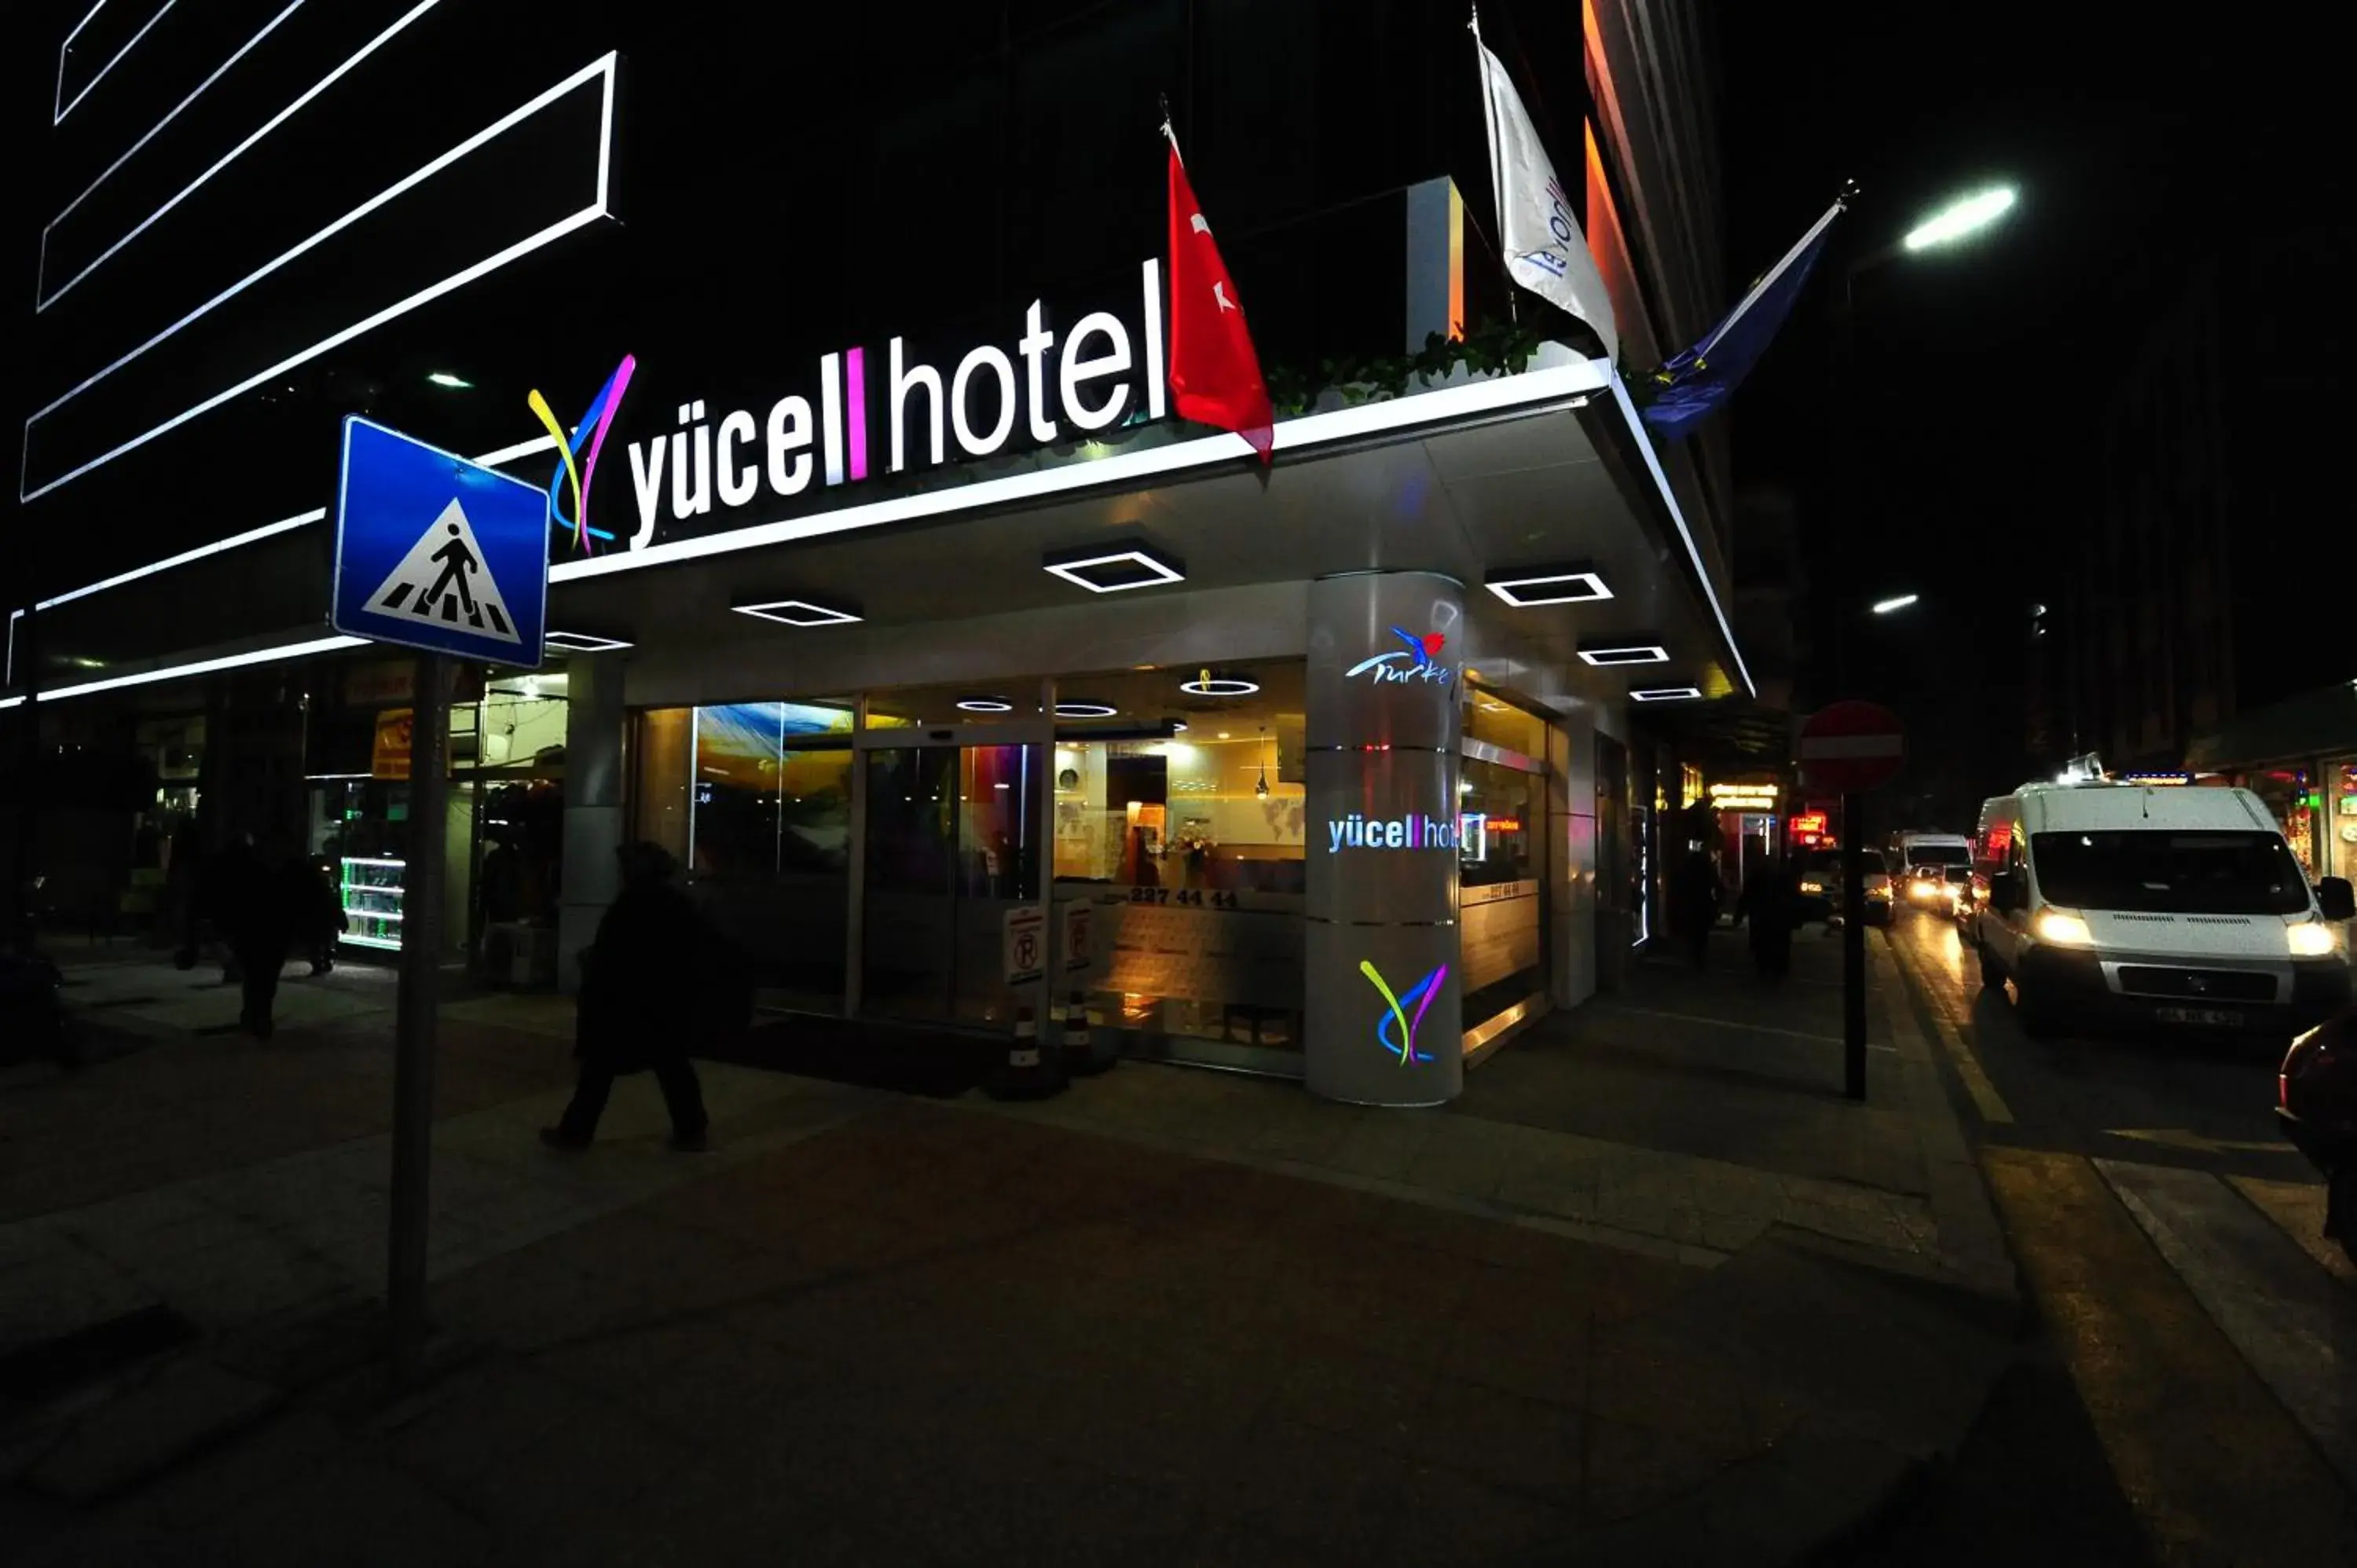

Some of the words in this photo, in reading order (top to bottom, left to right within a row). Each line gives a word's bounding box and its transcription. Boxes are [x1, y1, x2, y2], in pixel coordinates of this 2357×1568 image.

[628, 346, 867, 548] yücell
[890, 257, 1166, 473] hotel
[1328, 812, 1420, 853] yücell
